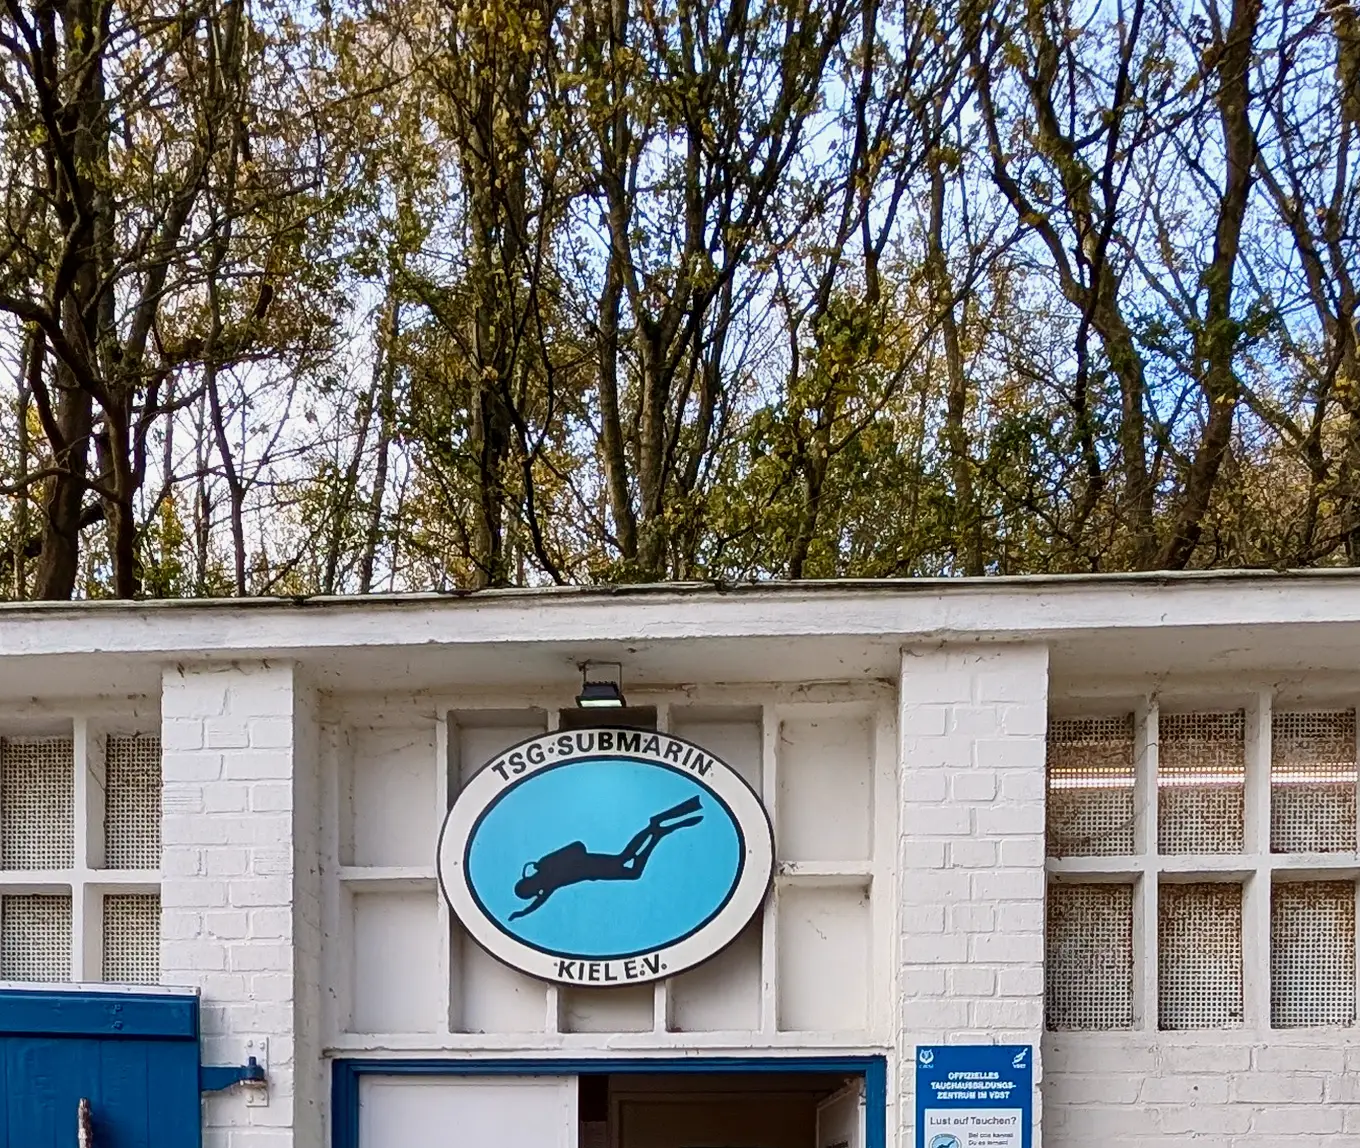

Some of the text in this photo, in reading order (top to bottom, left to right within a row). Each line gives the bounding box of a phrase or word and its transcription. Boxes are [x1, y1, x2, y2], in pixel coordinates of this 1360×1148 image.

[492, 732, 715, 782] TSG SUBMARIN
[558, 960, 617, 982] KIEL
[948, 1072, 1000, 1080] OFFIZIELLES
[936, 1091, 1011, 1100] ZENTRUM IM VDST
[930, 1116, 1017, 1125] Lust auf Tauchen?
